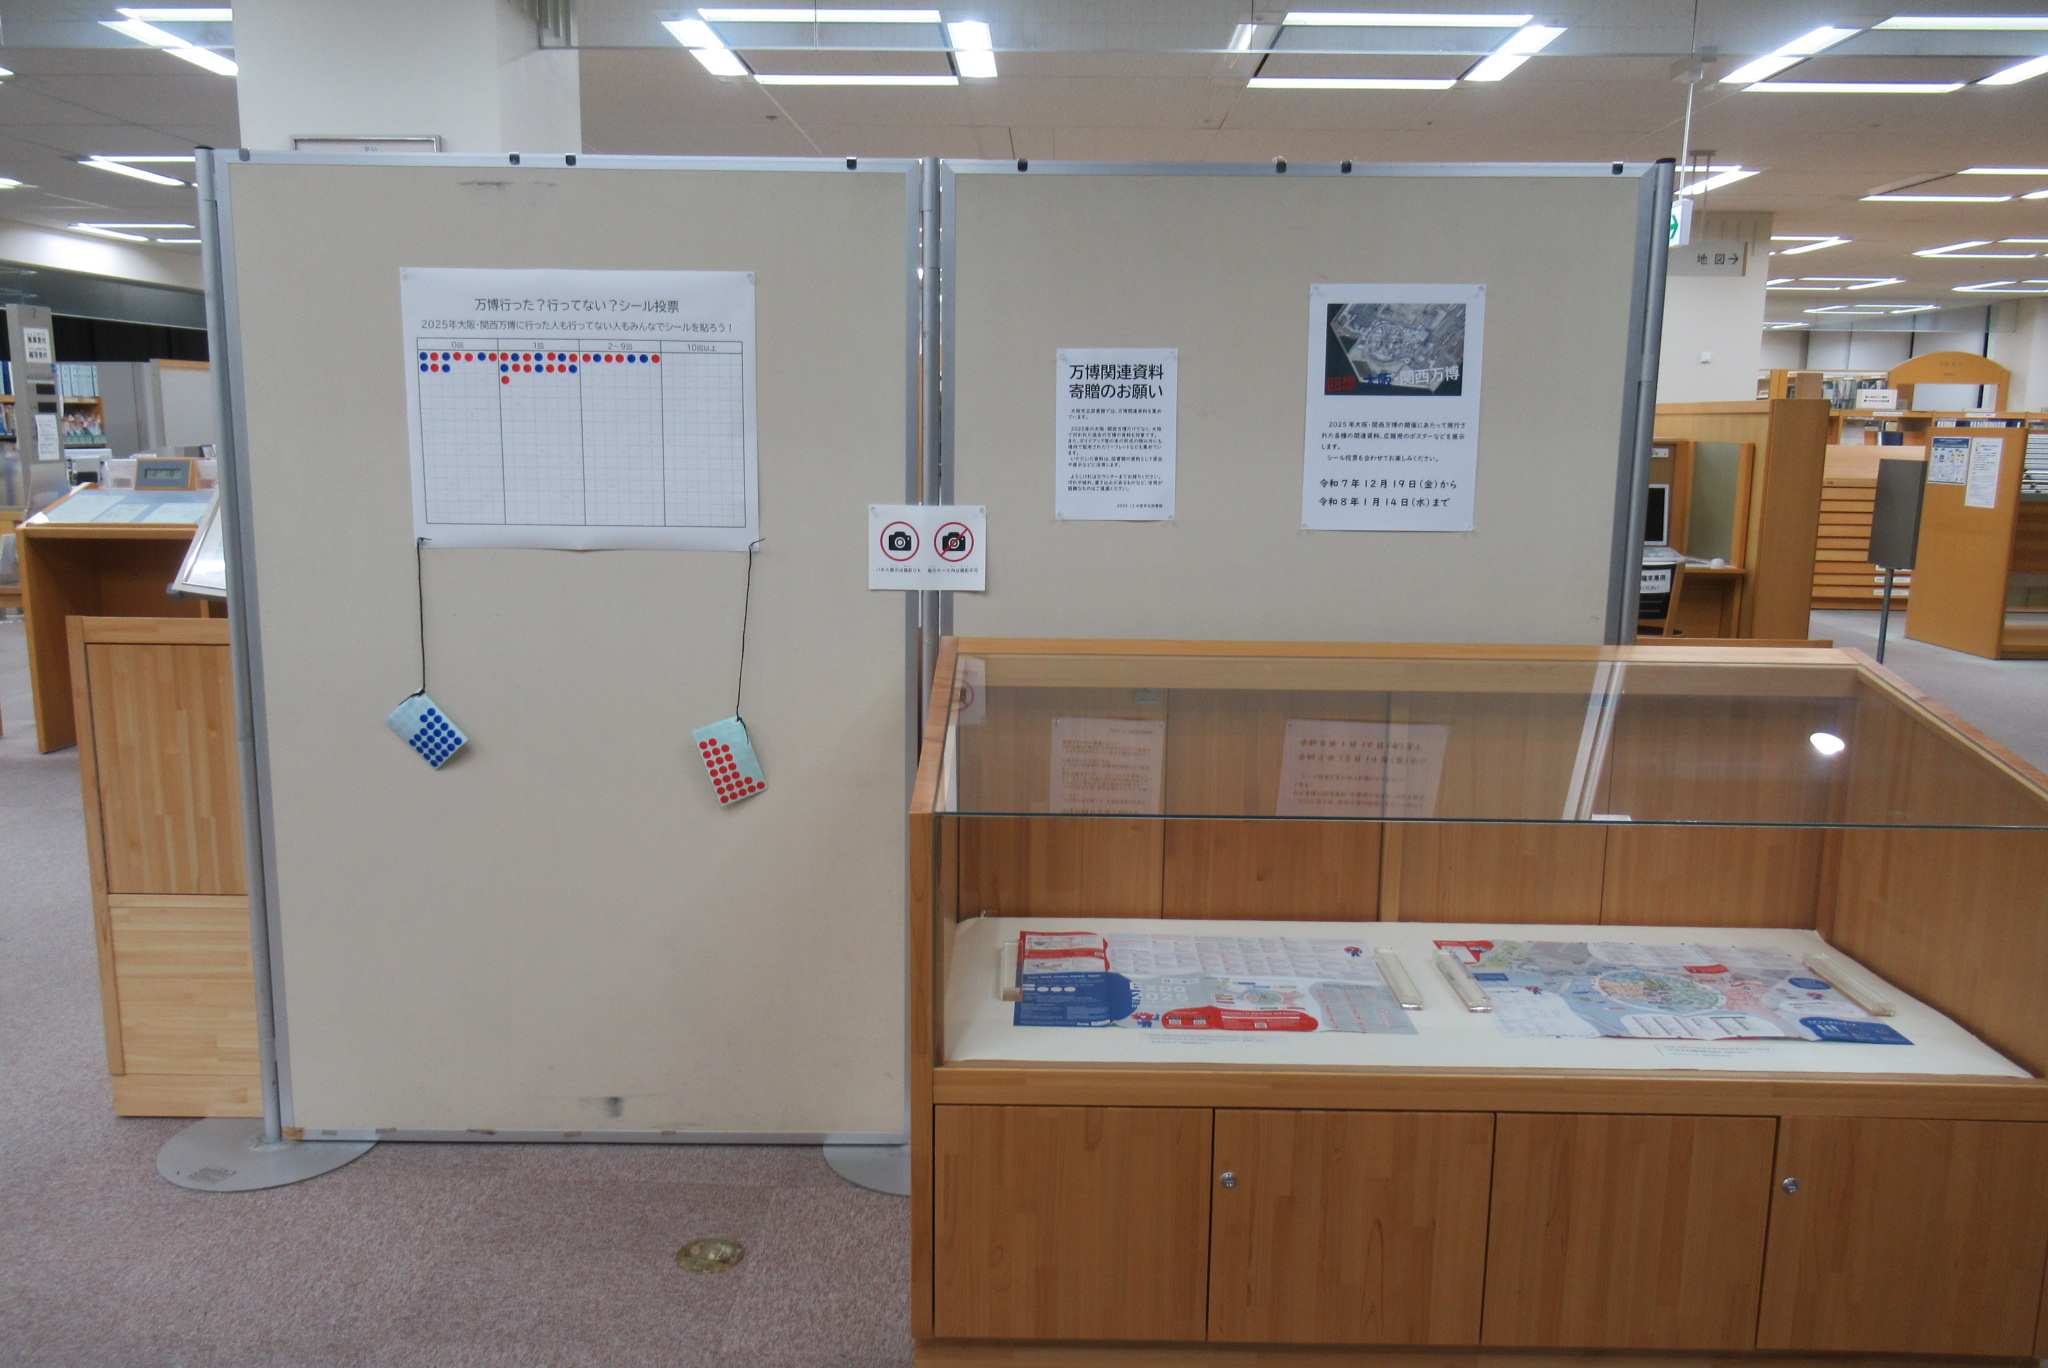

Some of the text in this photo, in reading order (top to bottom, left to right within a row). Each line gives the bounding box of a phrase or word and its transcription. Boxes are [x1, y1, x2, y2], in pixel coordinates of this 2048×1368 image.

[474, 298, 680, 313] 万博行った？行ってない？シール投票
[686, 344, 717, 352] 10回以上
[1069, 364, 1164, 381] 万博関連資料
[1069, 384, 1163, 399] 寄贈のお願い
[1327, 455, 1439, 463] シール投票も合わせてお楽しみください。
